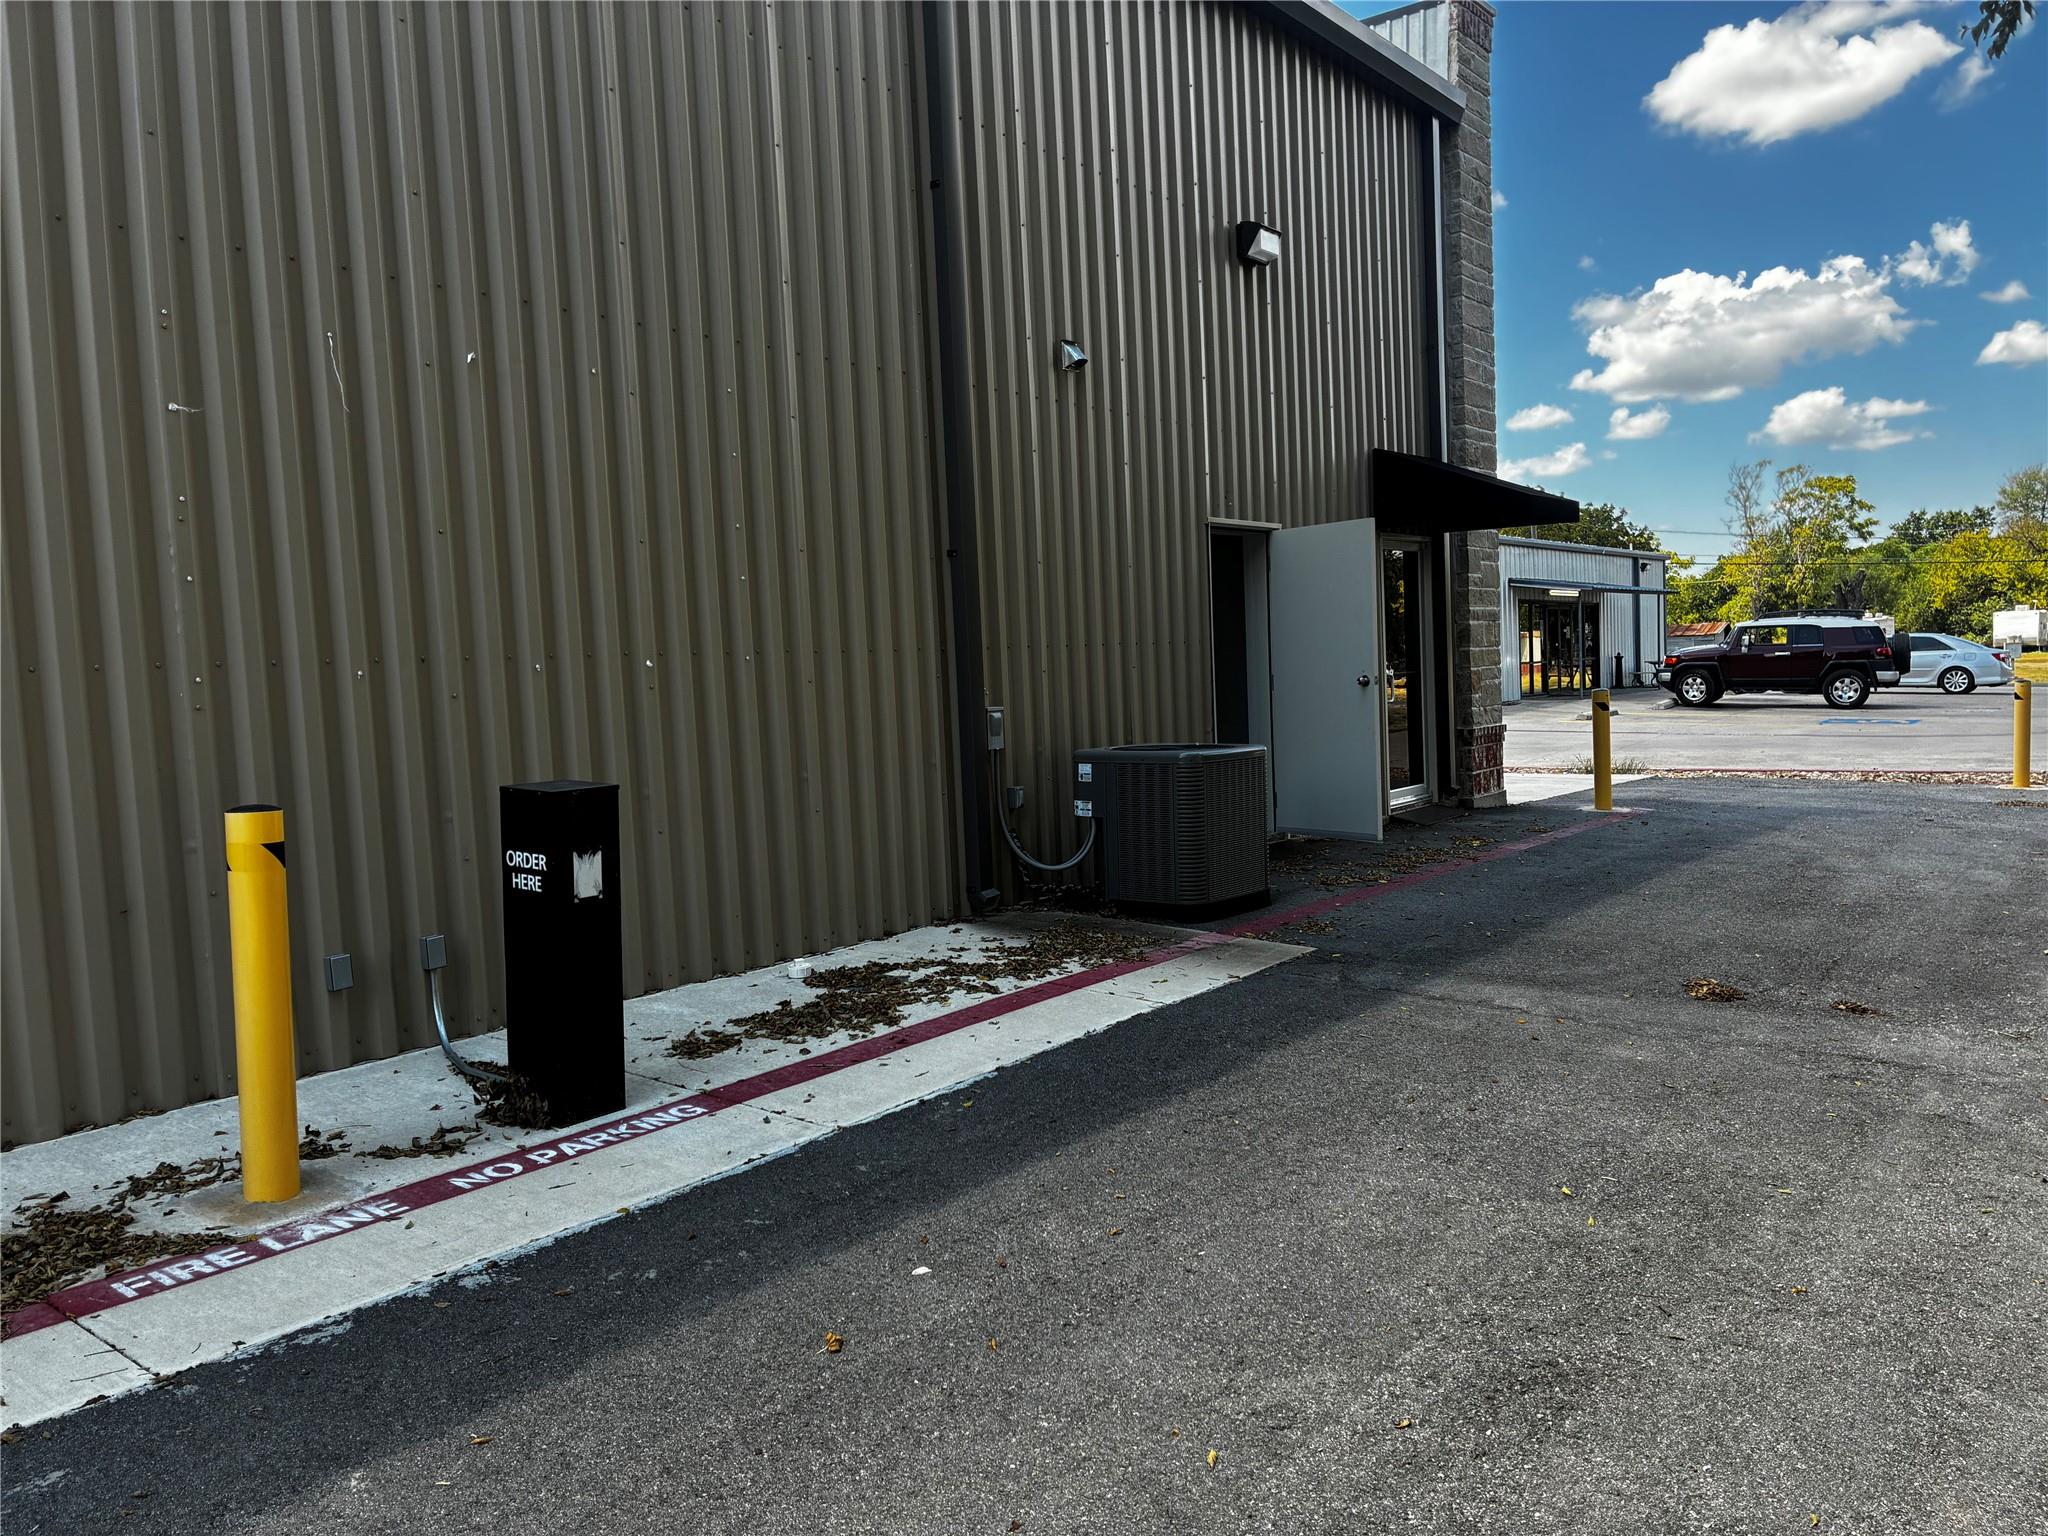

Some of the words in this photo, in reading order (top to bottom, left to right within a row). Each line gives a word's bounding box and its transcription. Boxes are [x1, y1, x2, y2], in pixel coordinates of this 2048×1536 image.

[506, 850, 547, 871] ORDER
[512, 872, 542, 892] HERE
[110, 1246, 257, 1298] FIRE
[258, 1199, 410, 1251] LANE
[450, 1163, 524, 1190] NO
[526, 1104, 708, 1165] PARKING
